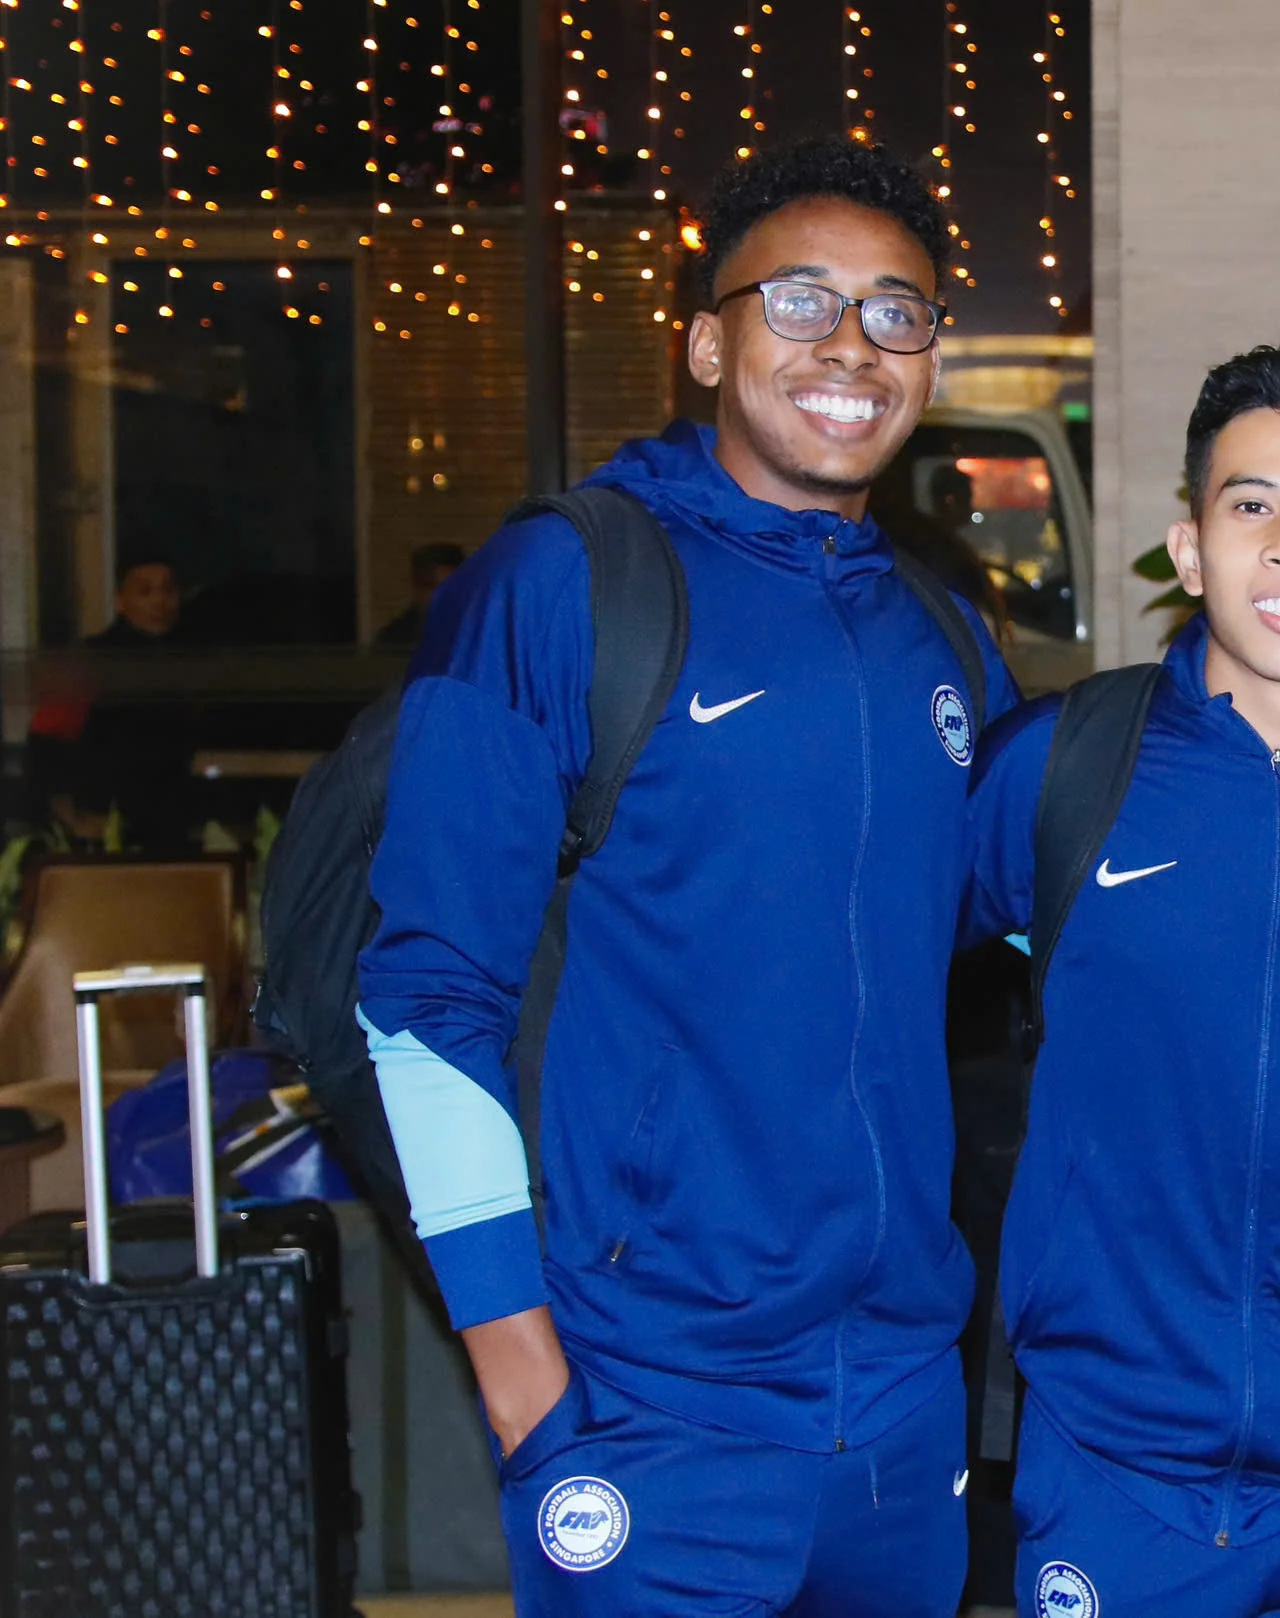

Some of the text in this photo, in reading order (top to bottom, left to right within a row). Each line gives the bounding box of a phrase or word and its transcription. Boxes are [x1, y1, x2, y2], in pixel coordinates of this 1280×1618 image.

[545, 1484, 622, 1539] FOOTBALL ASSOCIATION
[549, 1541, 606, 1563] SINGAPORE
